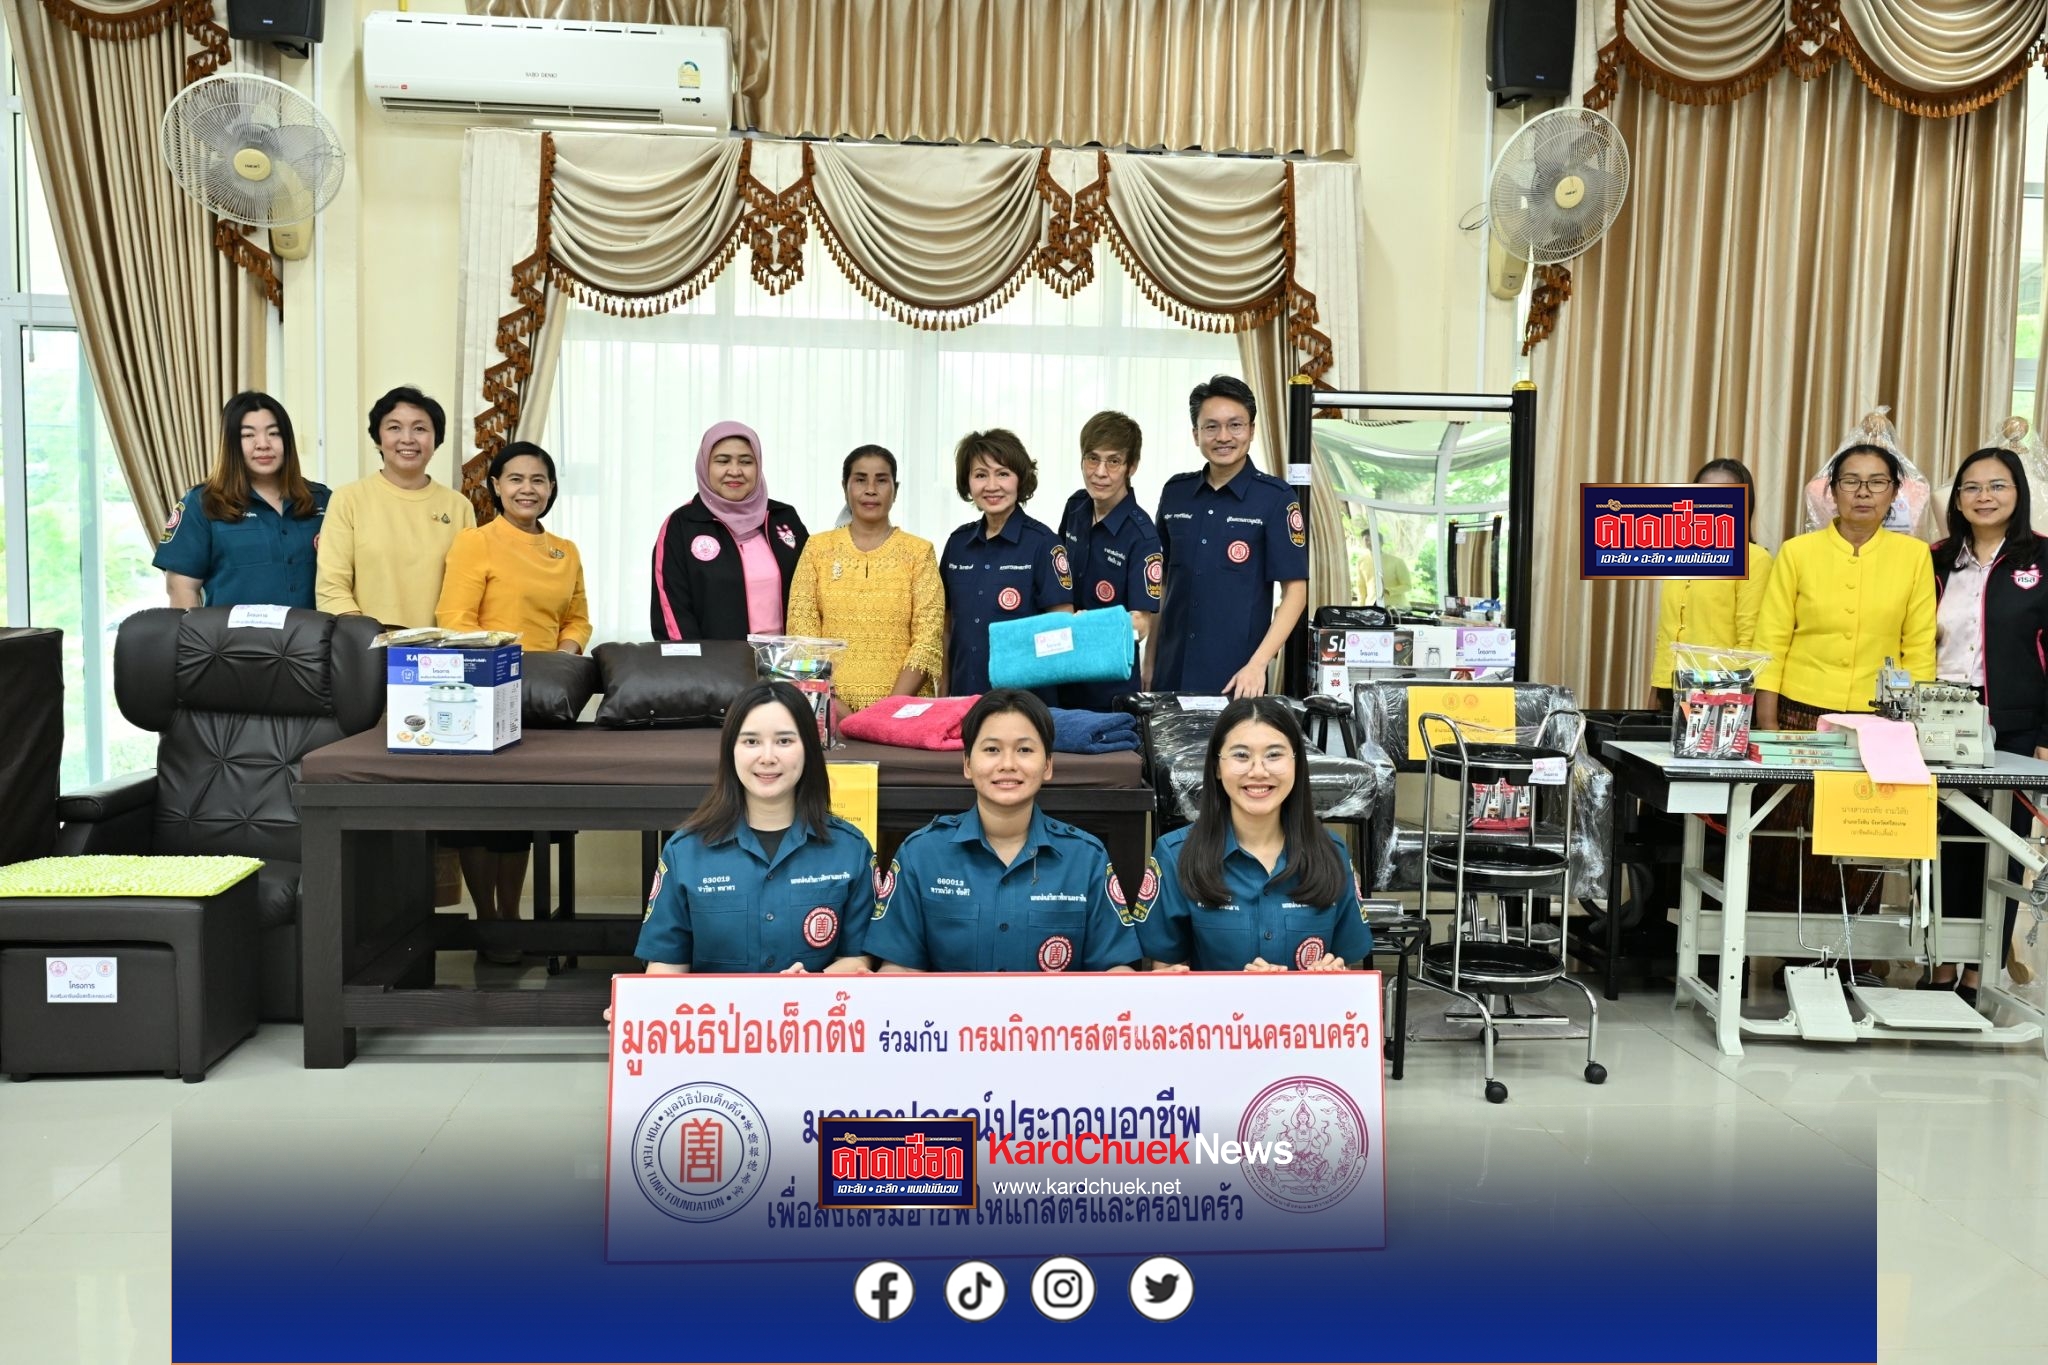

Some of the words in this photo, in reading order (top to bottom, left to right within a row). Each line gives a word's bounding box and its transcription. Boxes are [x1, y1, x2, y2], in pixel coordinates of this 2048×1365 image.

[68, 980, 96, 989] โครงการ
[621, 990, 866, 1077] มูลนิธิป่อเต็กตึ๊ง
[878, 1020, 949, 1053] ร่วมกับ
[958, 1010, 1370, 1053] กรมกิจการสตรีและสถาบันครอบครัว
[645, 1121, 662, 1143] POH
[643, 1144, 654, 1170] TECK
[646, 1170, 667, 1197] TUNG
[664, 1192, 725, 1212] FOUNDATION
